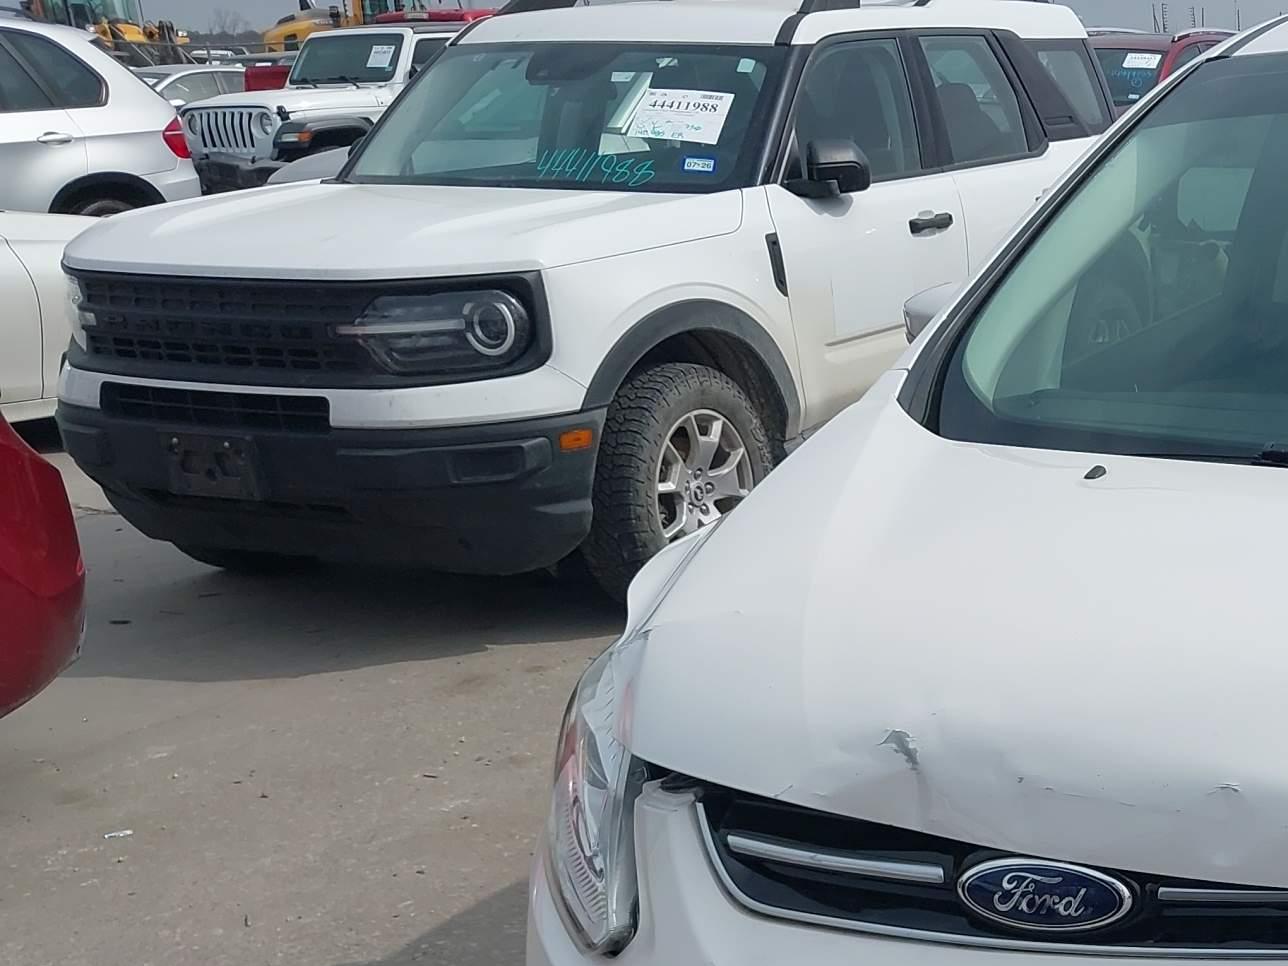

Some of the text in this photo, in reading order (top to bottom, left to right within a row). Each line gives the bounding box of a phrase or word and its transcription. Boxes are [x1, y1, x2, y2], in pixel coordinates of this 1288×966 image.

[648, 99, 719, 113] 44411988
[537, 147, 656, 187] 44411988
[993, 871, 1087, 917] Ford
